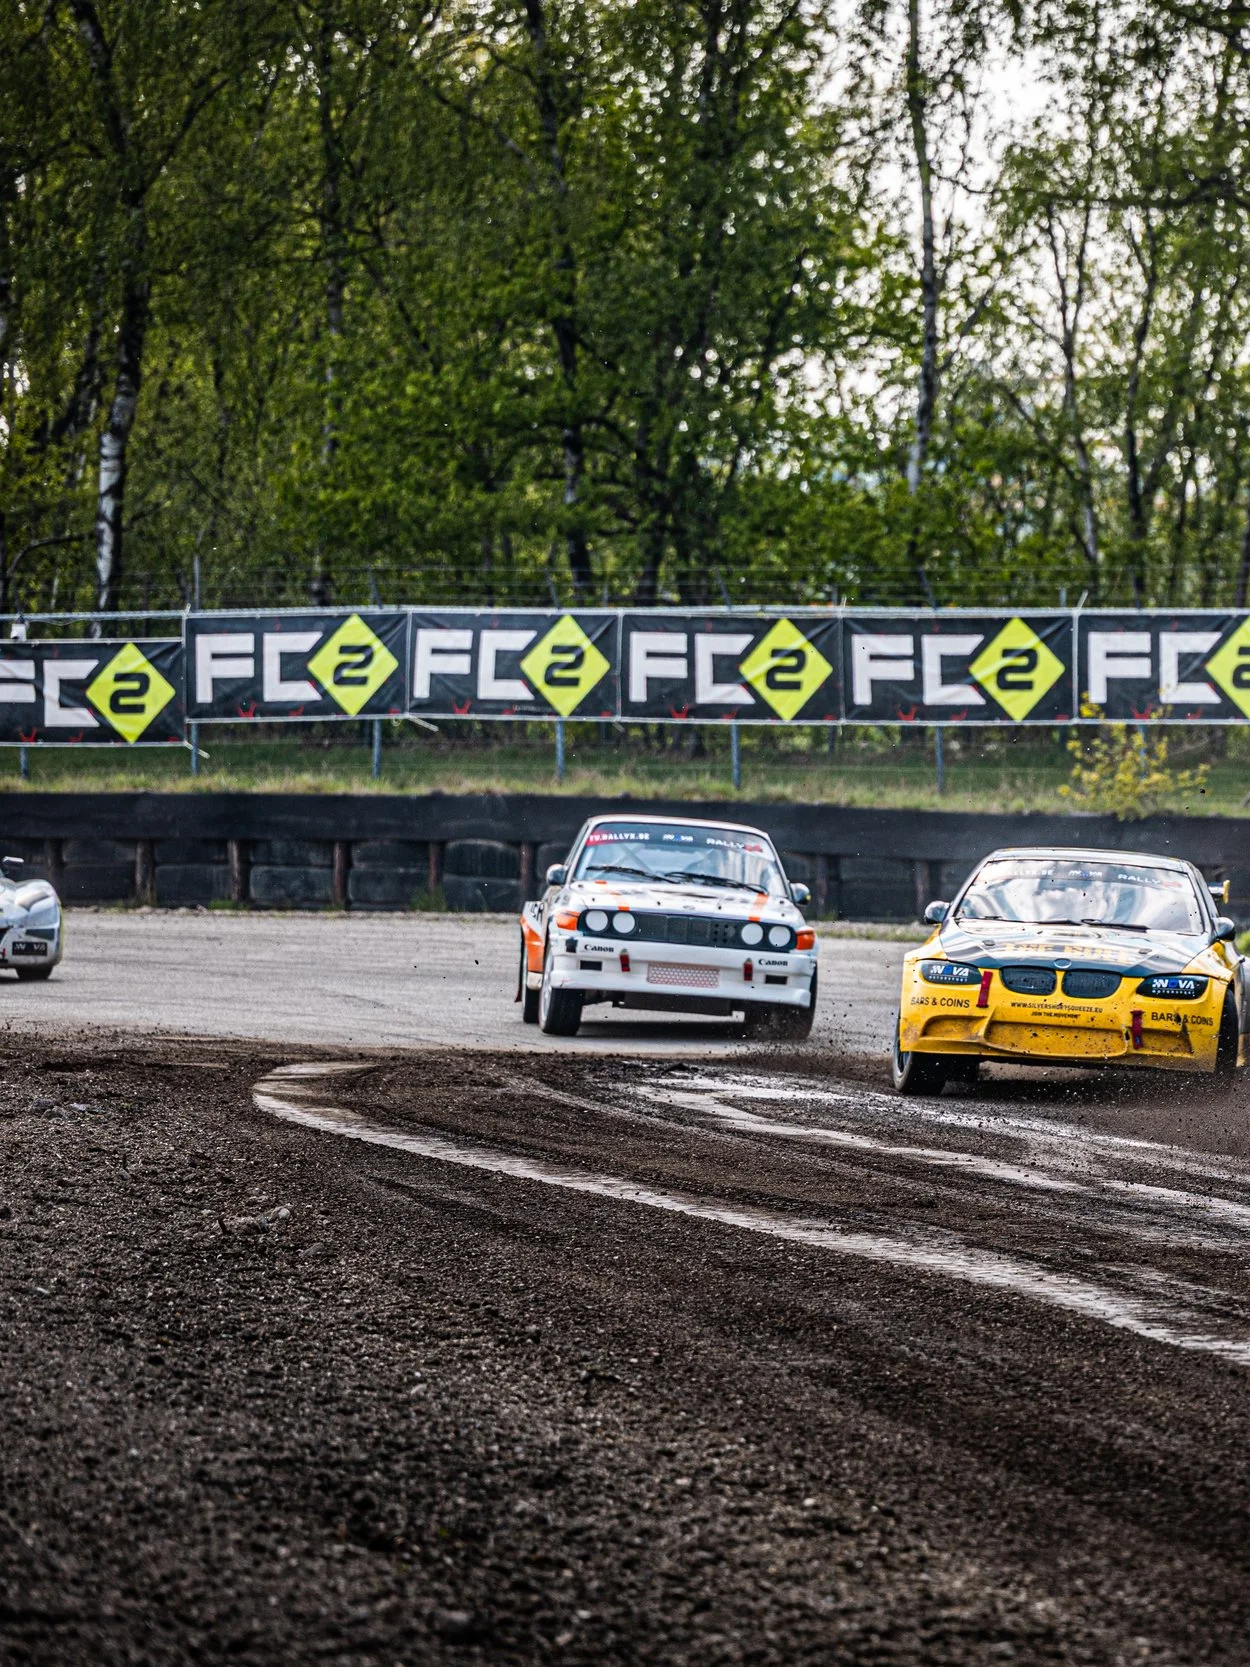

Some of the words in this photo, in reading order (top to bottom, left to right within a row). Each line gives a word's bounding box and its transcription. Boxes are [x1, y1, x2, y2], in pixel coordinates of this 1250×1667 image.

[589, 832, 650, 842] TV.RALLYX.SE
[584, 943, 614, 953] Canon
[758, 958, 788, 967] Canon
[929, 964, 970, 977] NOVA
[1151, 978, 1195, 989] NOVA
[911, 996, 930, 1006] BARS
[931, 997, 937, 1006] &
[940, 997, 970, 1009] COINS
[1151, 1011, 1181, 1023] BAR
[1183, 1014, 1189, 1024] &
[1190, 1015, 1214, 1027] COINS
